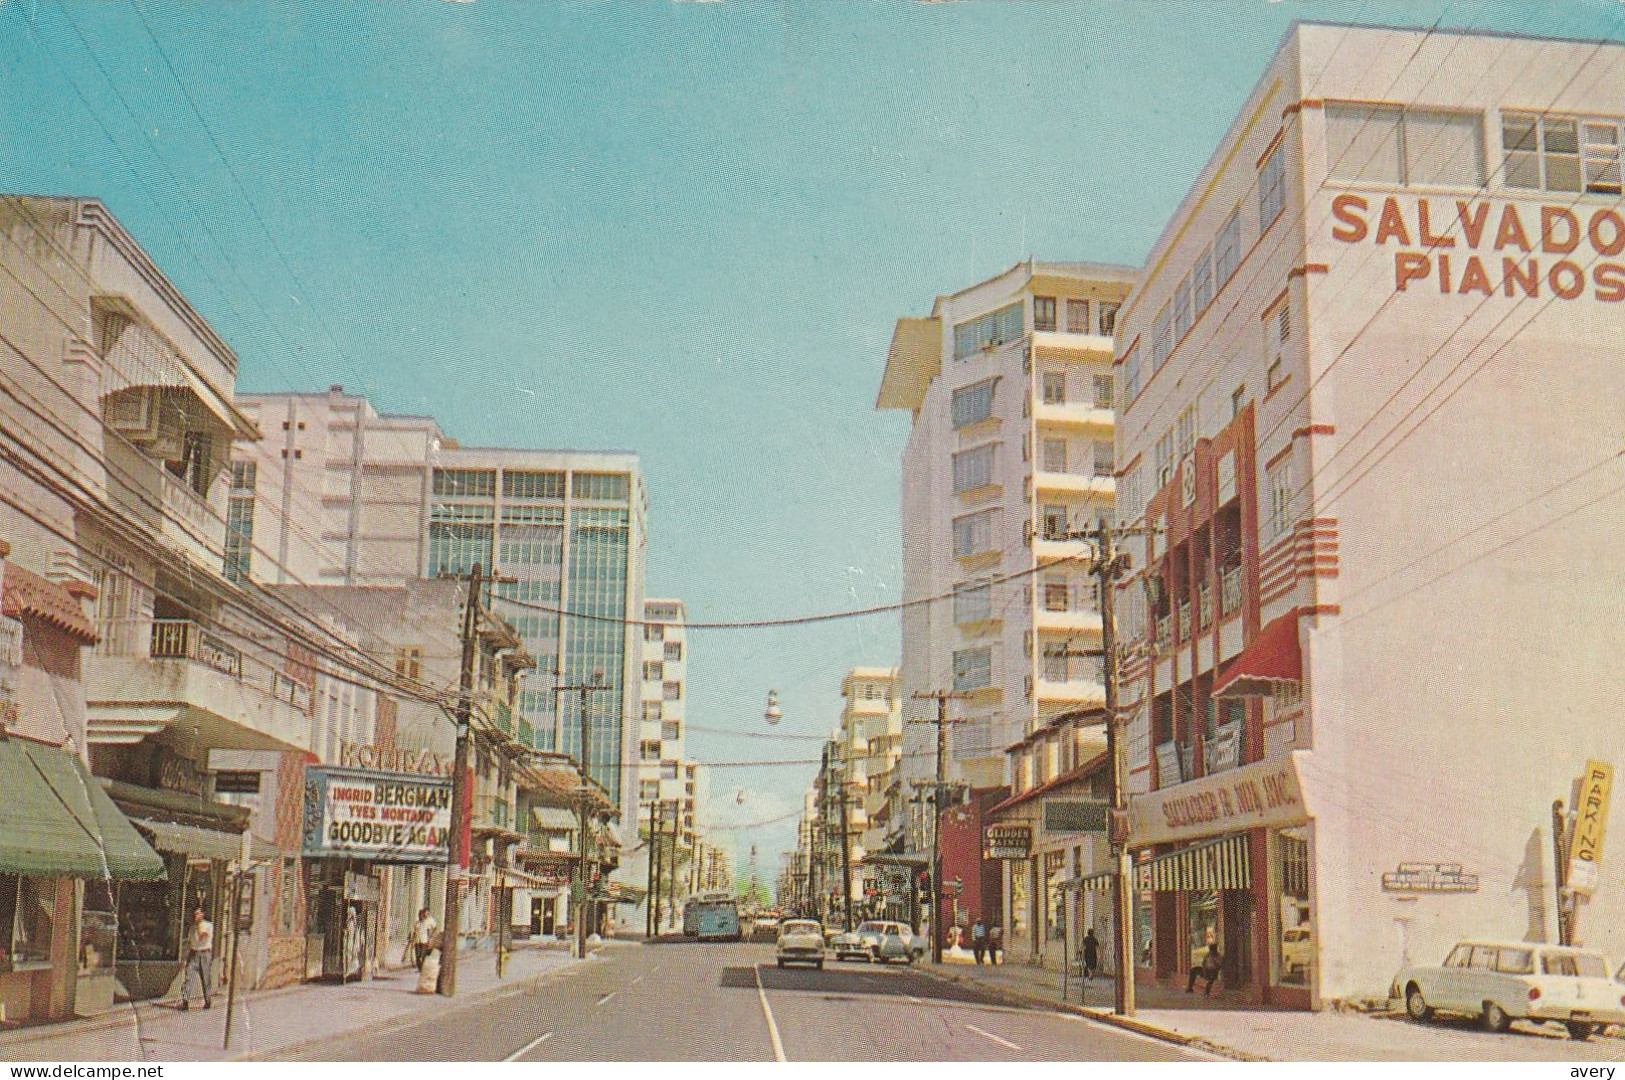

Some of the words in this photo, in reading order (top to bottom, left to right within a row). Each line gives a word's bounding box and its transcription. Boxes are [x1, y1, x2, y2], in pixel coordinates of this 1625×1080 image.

[1332, 194, 1625, 256] SALVADO
[1395, 252, 1625, 302] PIANOS
[333, 786, 372, 802] INGRID
[374, 783, 449, 810] BERGMAN
[349, 804, 376, 820] YVES
[381, 807, 434, 823] MONTAND
[1578, 769, 1606, 862] PARKING
[328, 821, 403, 845] GOODBYE
